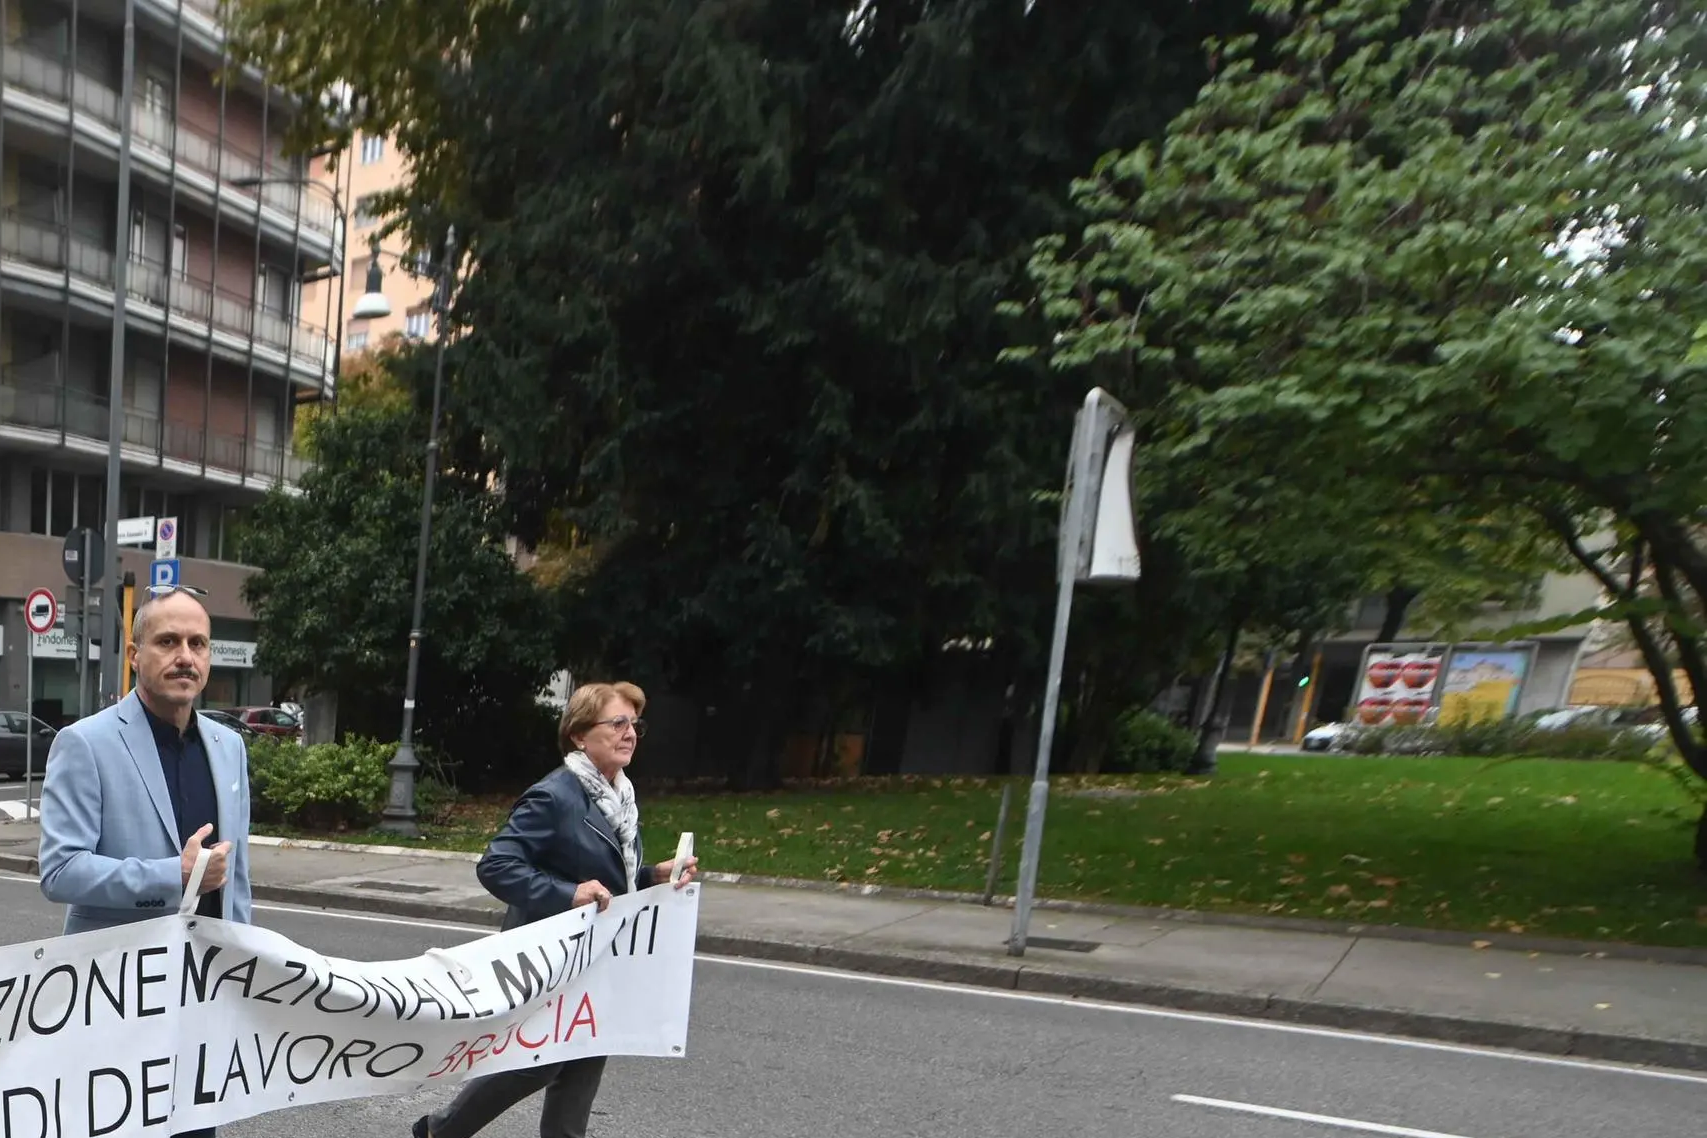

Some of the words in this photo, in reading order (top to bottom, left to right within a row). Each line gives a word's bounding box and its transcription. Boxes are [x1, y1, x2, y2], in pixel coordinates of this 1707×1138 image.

[180, 941, 494, 1021] NAZIONALE
[87, 1055, 178, 1138] DE
[194, 1031, 424, 1105] LAVORO
